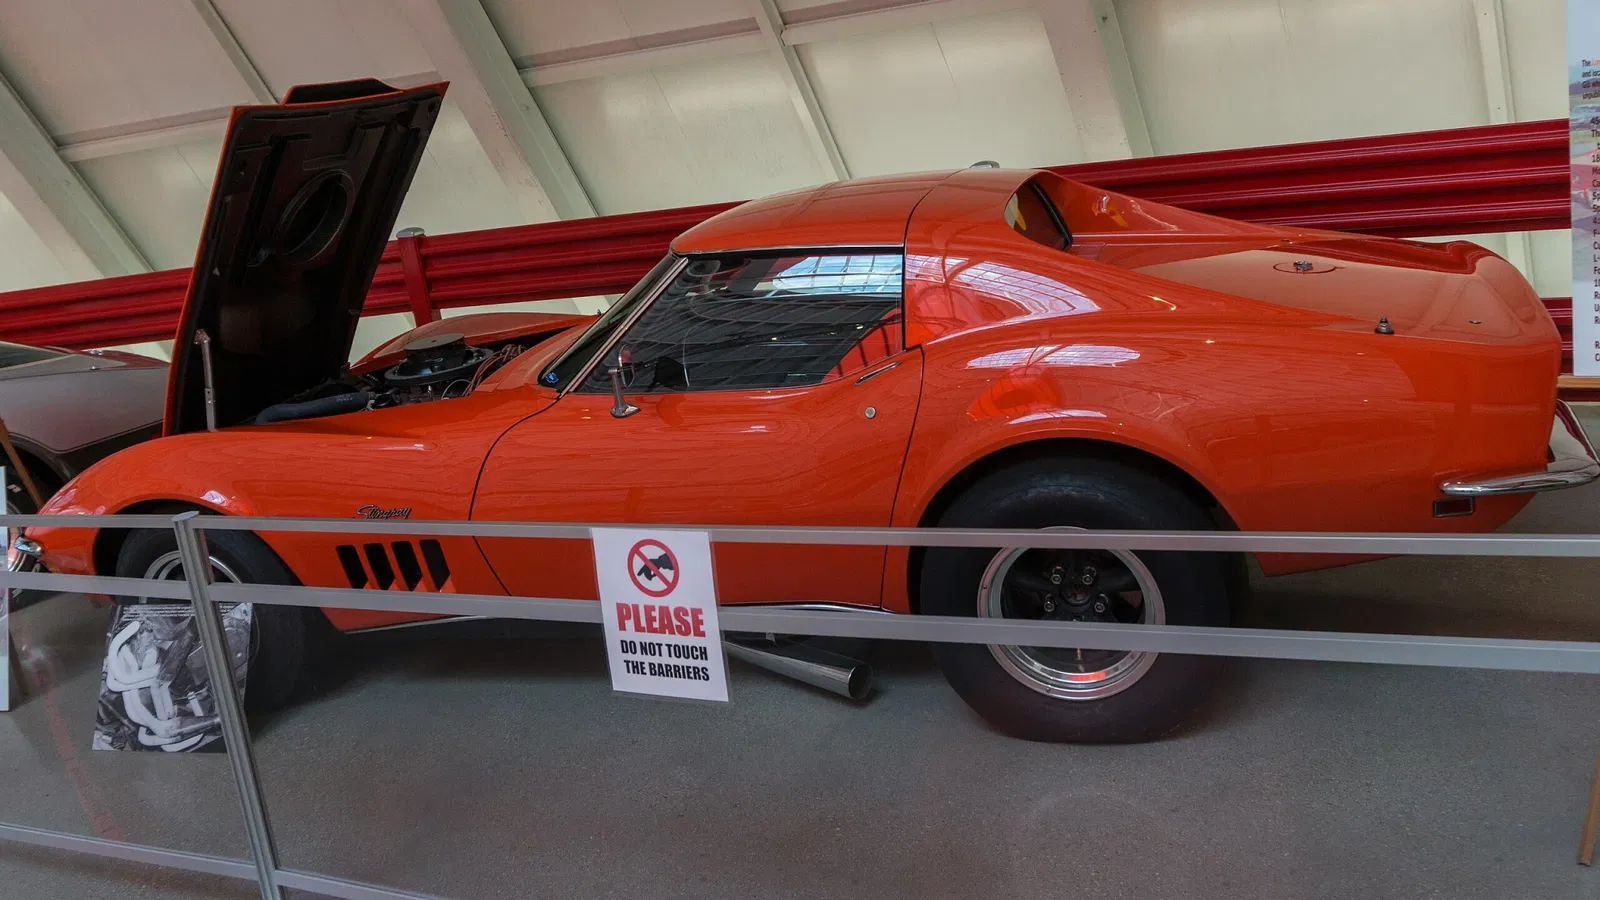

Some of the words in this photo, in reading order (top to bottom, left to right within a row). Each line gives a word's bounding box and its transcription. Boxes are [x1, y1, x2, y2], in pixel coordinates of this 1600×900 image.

[357, 504, 412, 520] Stingray
[615, 602, 706, 638] PLEASE
[620, 639, 637, 655] DO
[639, 641, 663, 657] NOT
[665, 643, 709, 661] TOUCH
[623, 659, 647, 676] THE
[648, 662, 710, 682] BARRIERS
